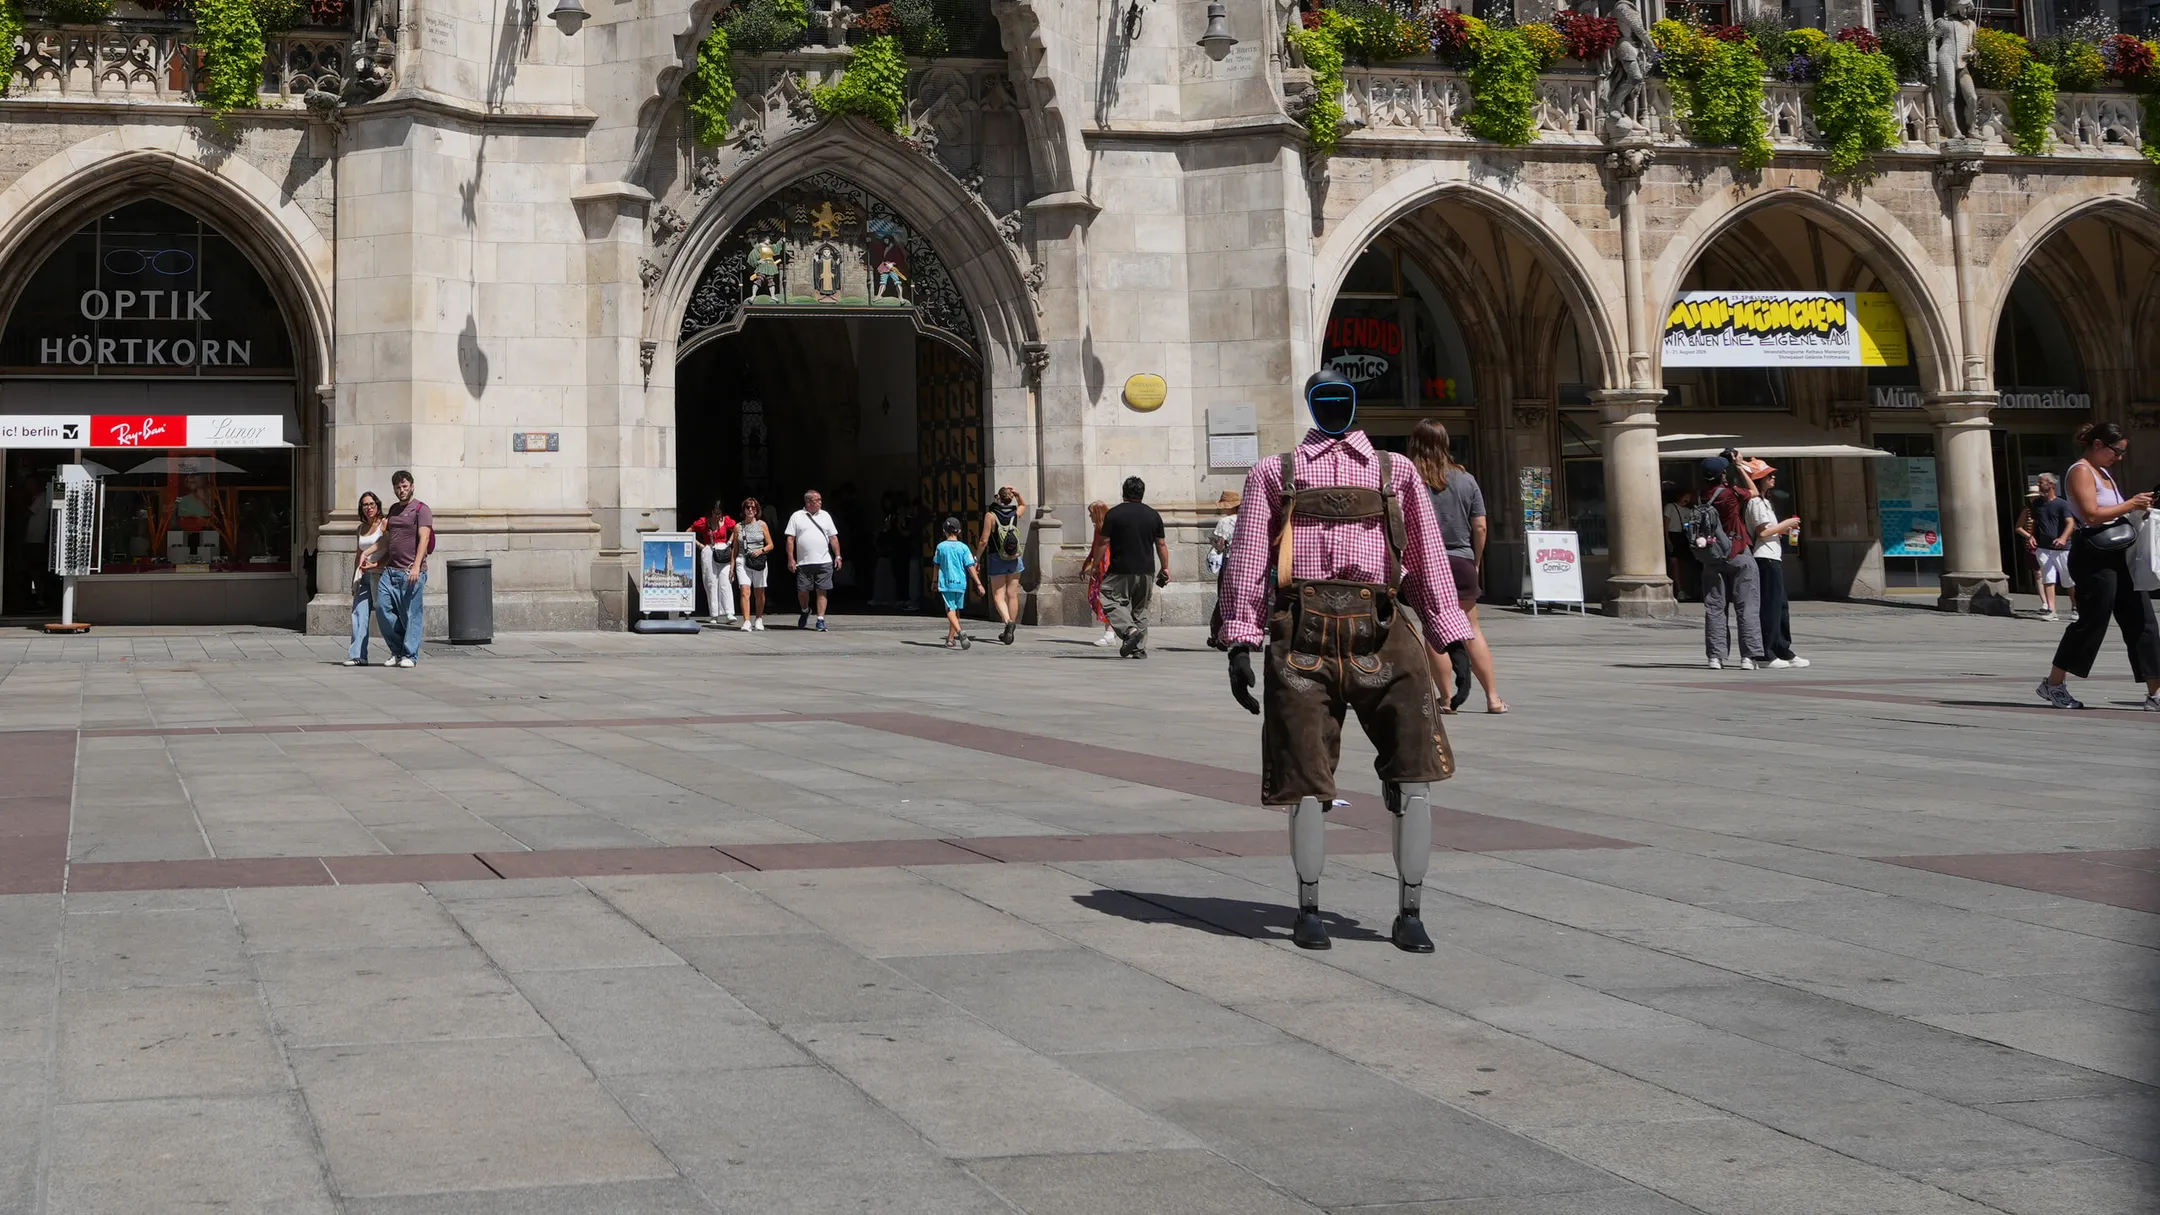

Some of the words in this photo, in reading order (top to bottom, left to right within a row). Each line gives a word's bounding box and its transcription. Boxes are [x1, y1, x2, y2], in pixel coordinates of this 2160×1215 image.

[80, 289, 213, 321] OPTIK
[1664, 296, 1847, 335] MINI-MÜNCHEN
[1325, 316, 1402, 355] LENDID
[1664, 330, 1686, 347] WIR
[1689, 330, 1720, 347] BAUEN
[1723, 328, 1754, 347] EINE
[1759, 332, 1818, 347] EIGENE
[40, 334, 251, 366] HÖRTKORN
[1876, 387, 1925, 408] Mün
[2, 426, 17, 437] ic!
[22, 426, 58, 437] berlin
[110, 417, 167, 446] Ray-Ban
[204, 418, 266, 440] Lunor
[1543, 563, 1570, 572] Comics
